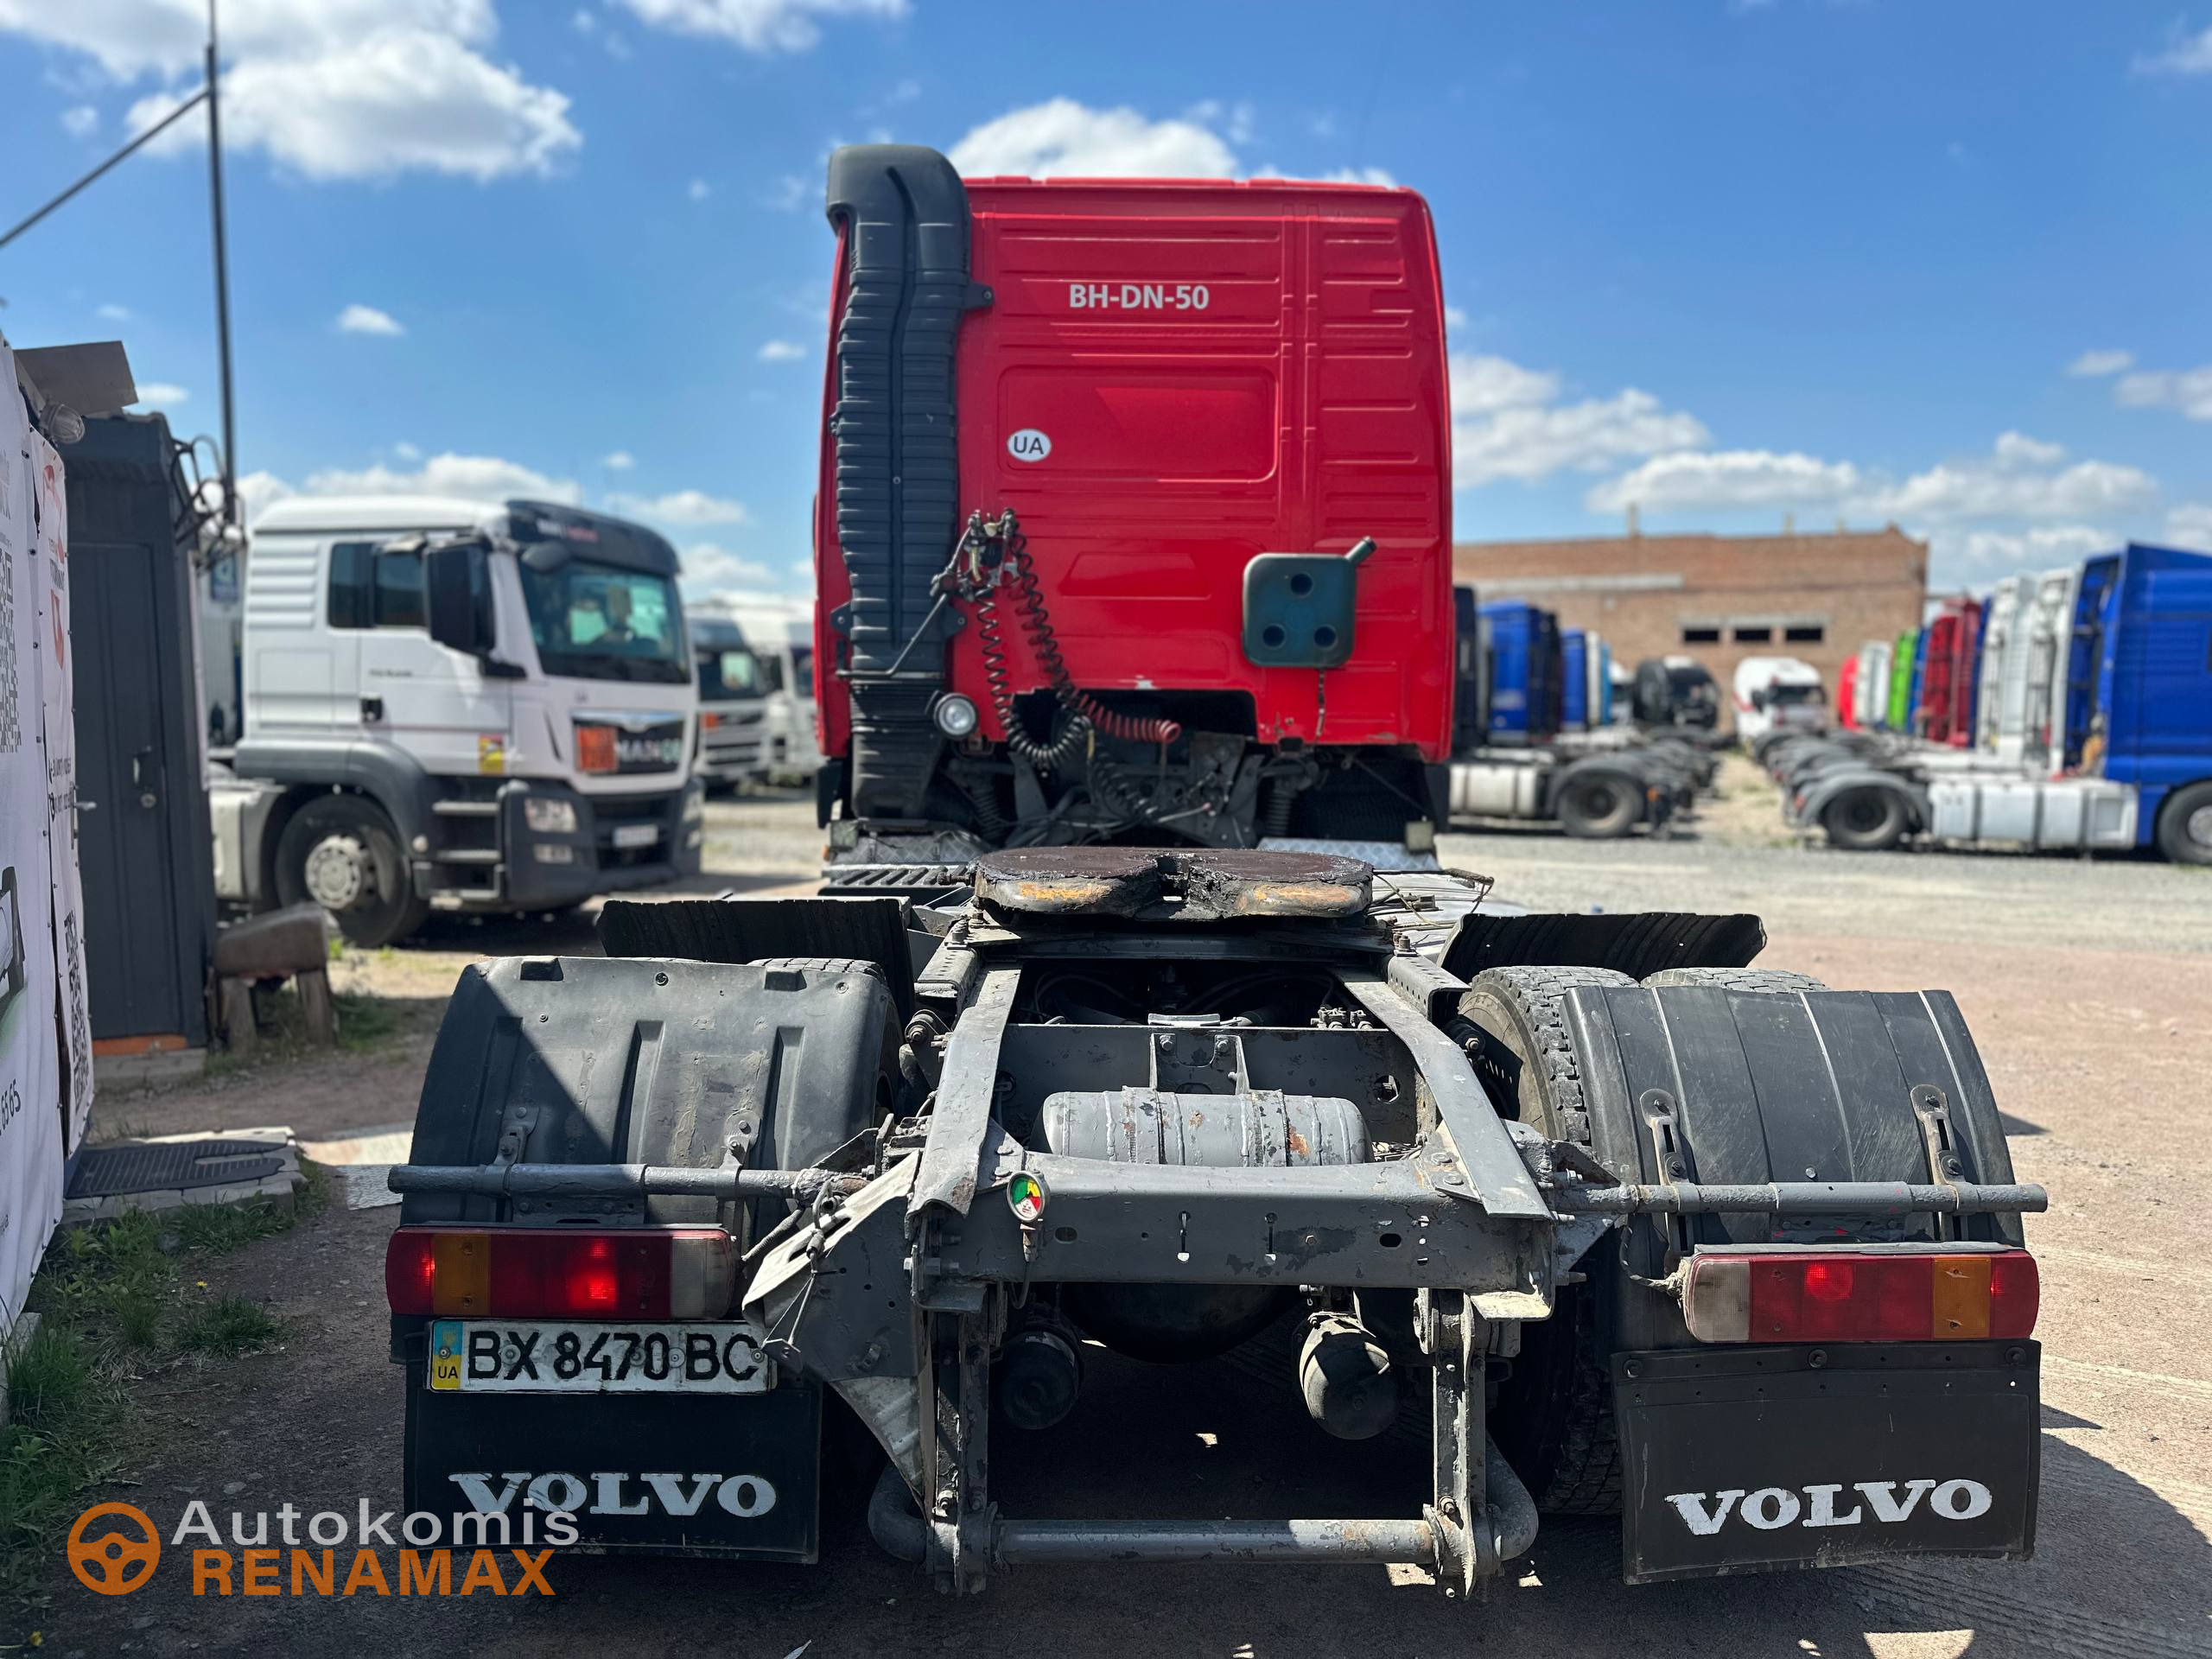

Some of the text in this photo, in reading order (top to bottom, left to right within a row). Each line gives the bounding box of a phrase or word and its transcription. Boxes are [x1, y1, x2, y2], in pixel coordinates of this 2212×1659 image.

[1070, 284, 1210, 309] BH-DN-50
[1013, 435, 1045, 455] UA
[438, 1365, 459, 1380] UA
[467, 1331, 762, 1381] BX 8470 BC
[448, 1471, 778, 1518] VOLVO
[1664, 1478, 1993, 1535] VOLVO
